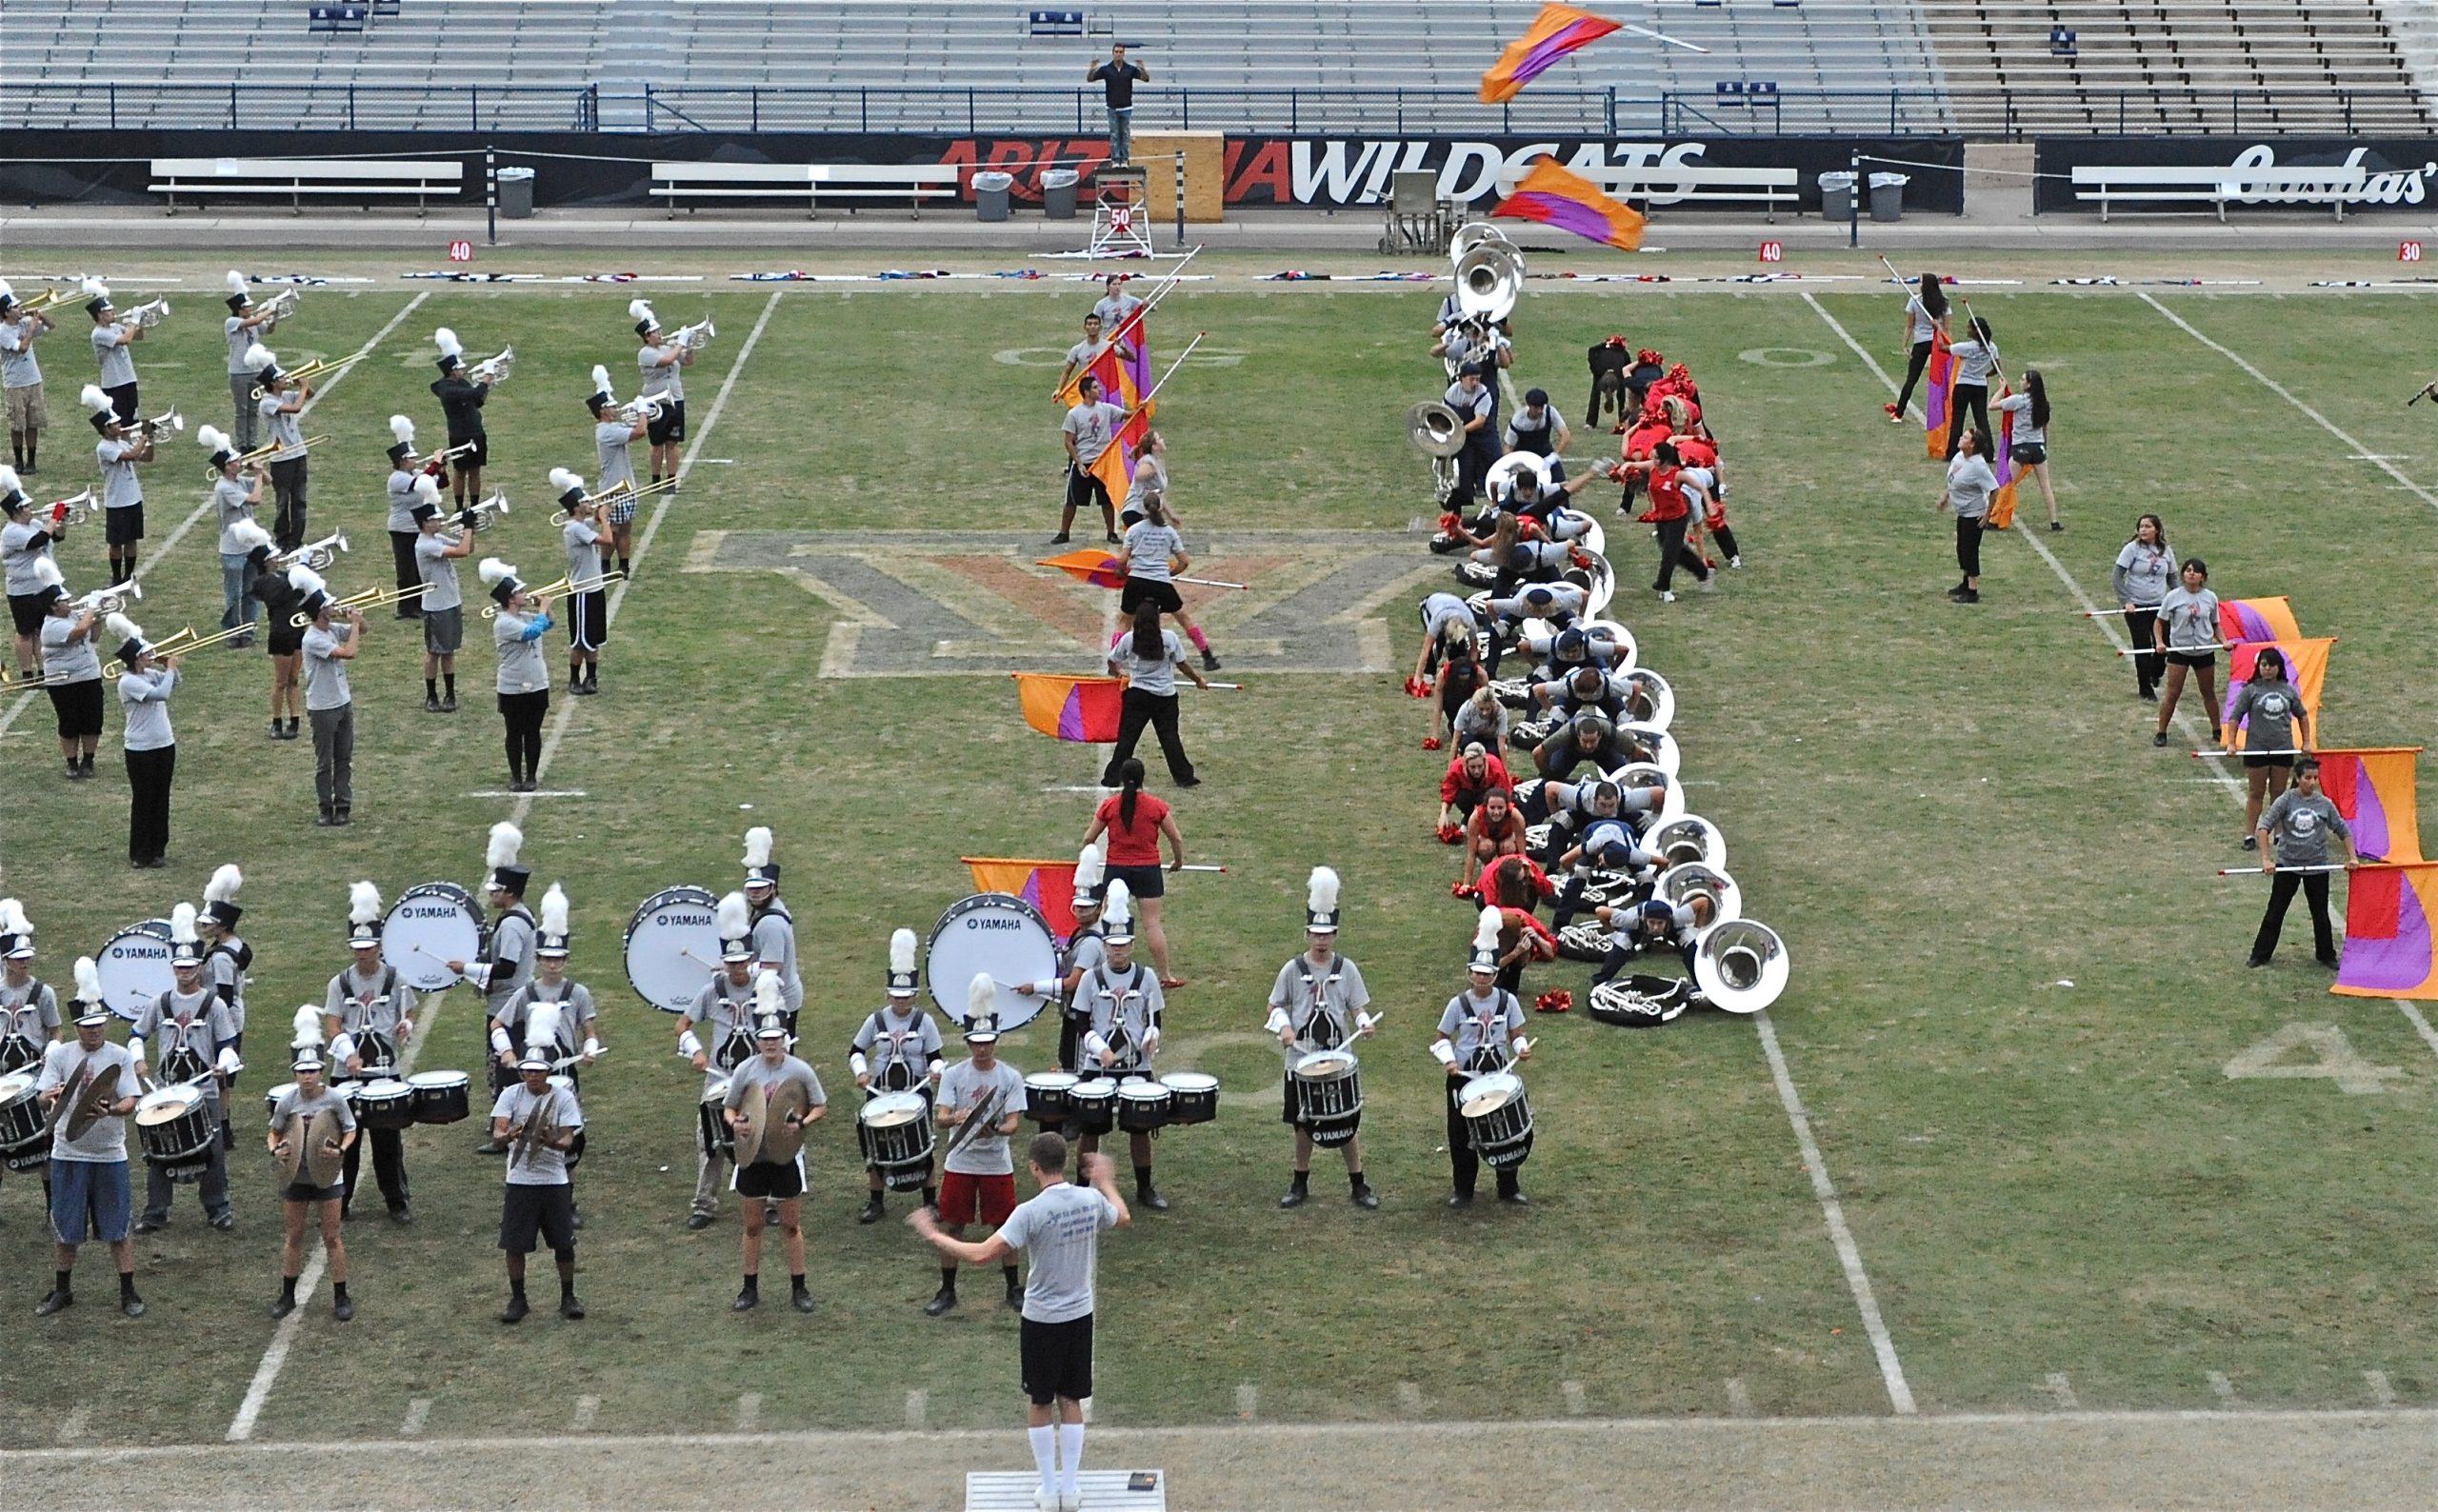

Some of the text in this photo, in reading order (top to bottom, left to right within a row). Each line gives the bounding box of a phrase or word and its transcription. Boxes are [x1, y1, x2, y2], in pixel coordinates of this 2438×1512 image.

[917, 140, 1290, 203] ARIZA
[1110, 209, 1129, 226] 50
[450, 242, 470, 261] 40
[1762, 243, 1781, 262] 40
[2402, 242, 2420, 261] 30
[415, 906, 457, 919] YAMAHA
[669, 915, 712, 926] YAMAHA
[979, 919, 1022, 930] YAMAHA
[125, 947, 168, 960] YAMAHA
[1496, 1145, 1528, 1164] YAMAHA
